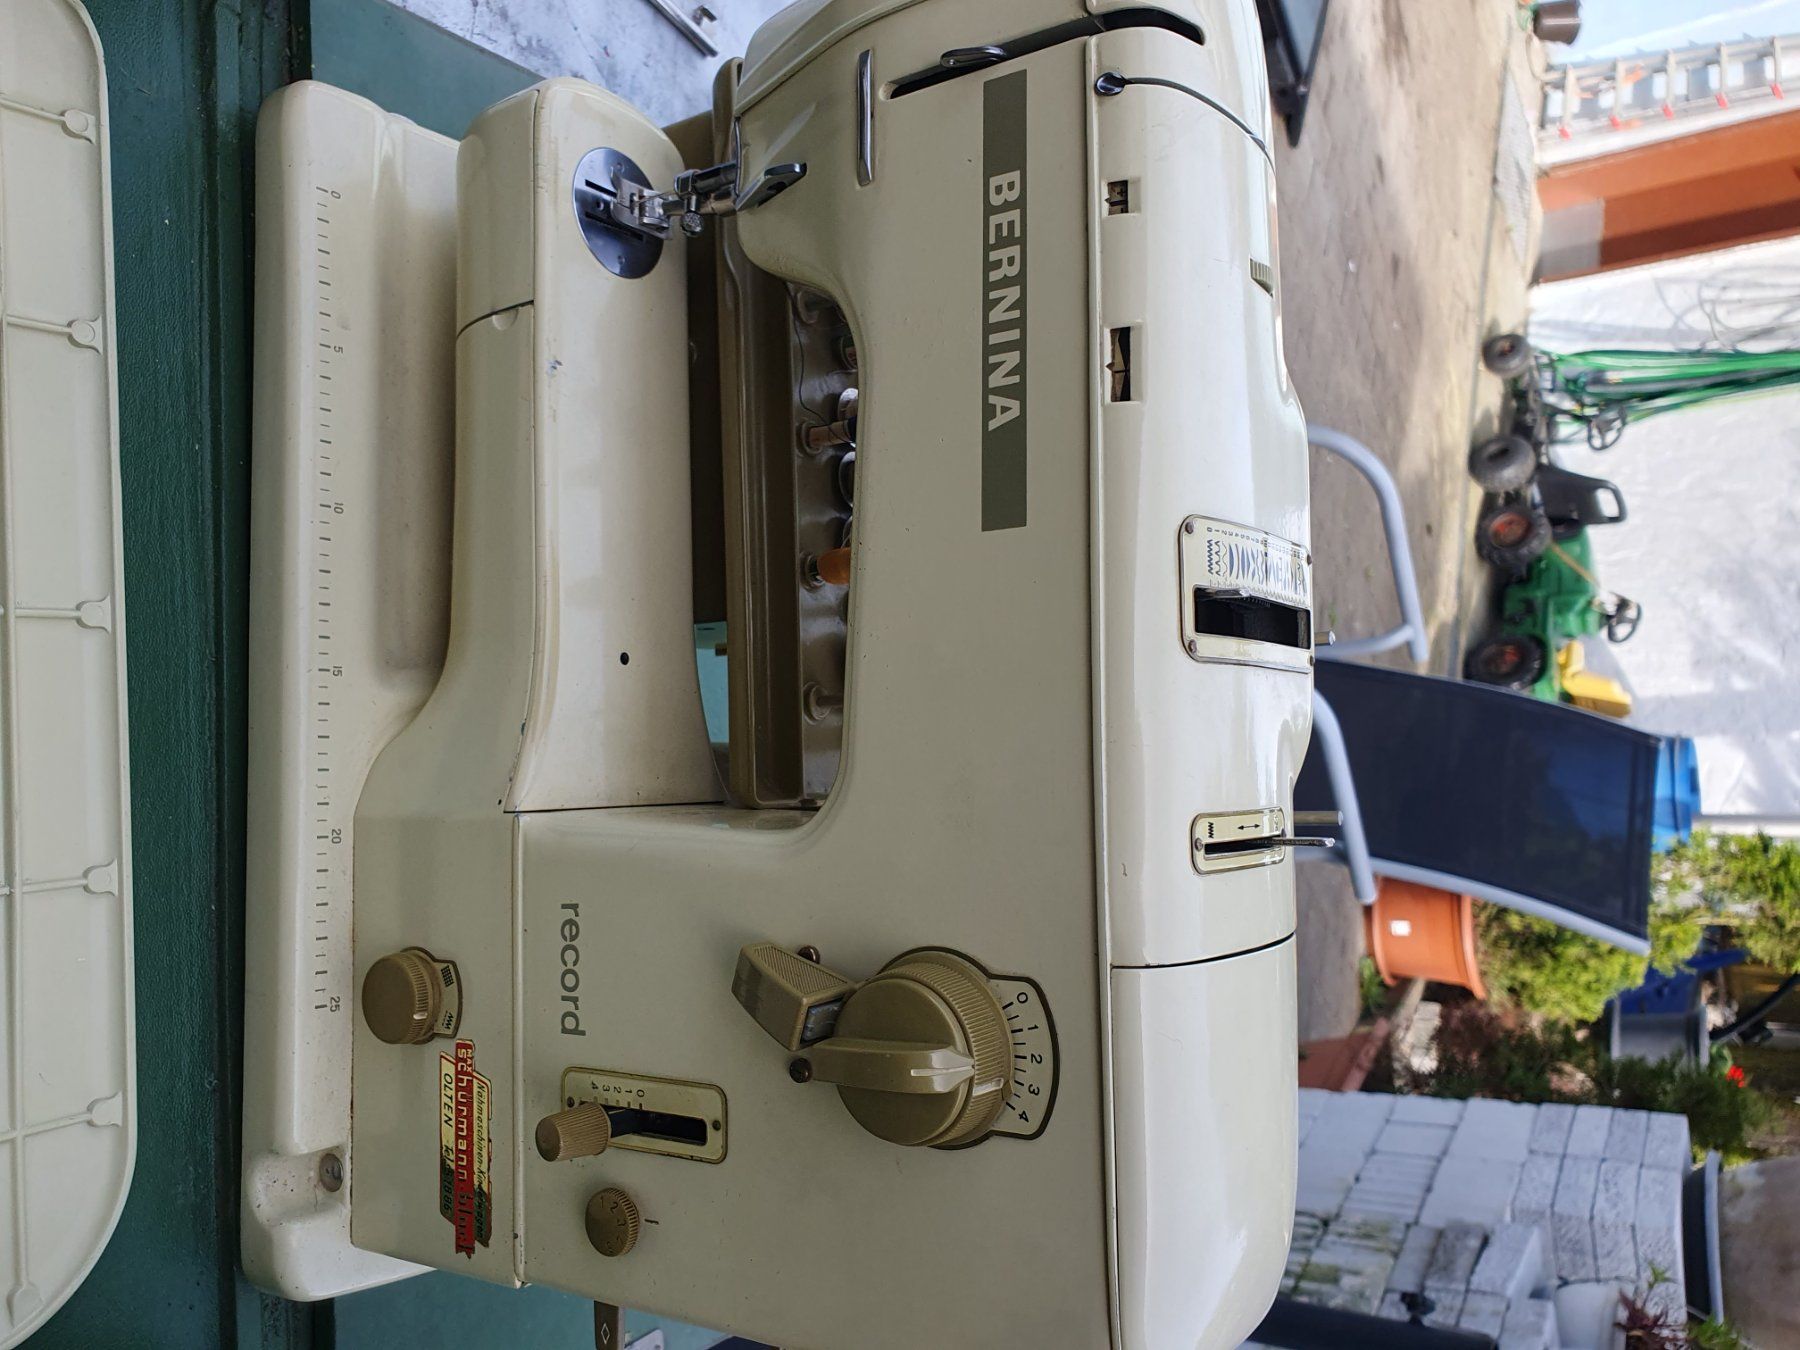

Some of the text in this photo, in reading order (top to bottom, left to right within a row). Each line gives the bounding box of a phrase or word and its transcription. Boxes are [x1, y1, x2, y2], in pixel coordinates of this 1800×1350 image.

[988, 170, 1021, 432] BERNINA
[330, 189, 344, 1013] 0 5 10 15 20 25
[560, 903, 587, 1037] record
[1016, 991, 1029, 1004] 0
[1030, 1053, 1043, 1064] 2
[602, 1084, 610, 1092] 3
[613, 1086, 622, 1094] 2
[636, 1089, 645, 1098] 0
[1028, 1083, 1040, 1096] 3
[443, 1073, 454, 1129] OLTEN
[1018, 1110, 1030, 1123] 4
[610, 1201, 619, 1214] 2
